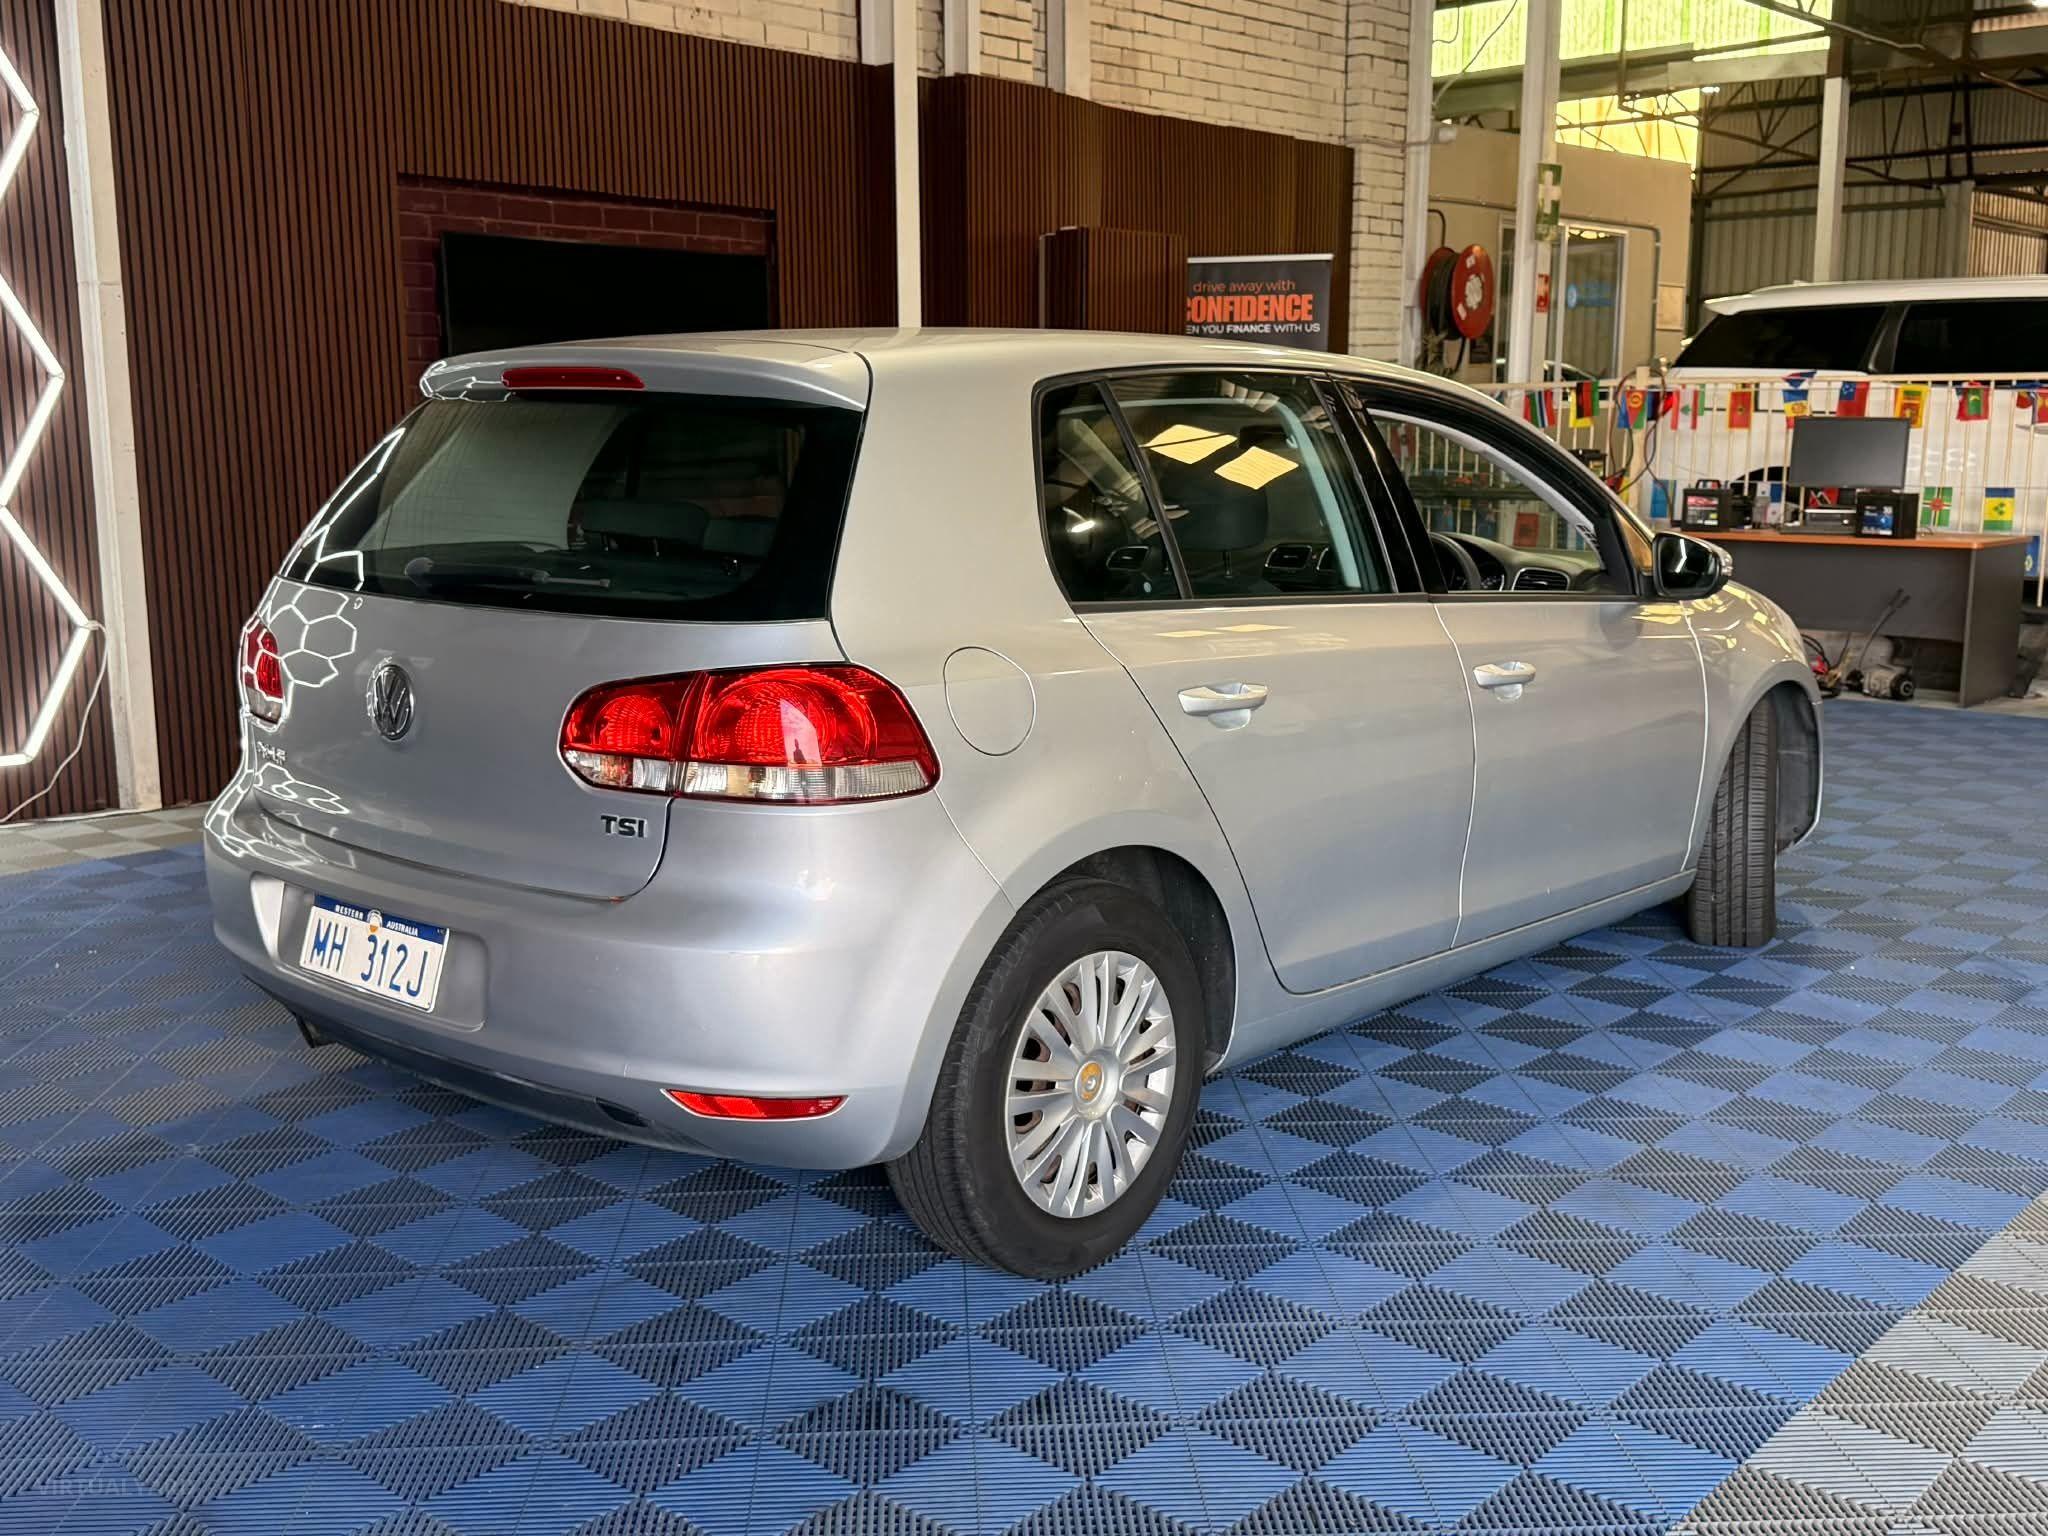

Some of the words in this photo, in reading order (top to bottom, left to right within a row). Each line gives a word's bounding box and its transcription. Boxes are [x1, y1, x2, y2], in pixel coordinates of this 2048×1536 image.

[1193, 282, 1226, 293] drive
[1229, 284, 1263, 295] away
[1264, 280, 1296, 291] with
[1202, 324, 1225, 334] YOU
[1226, 324, 1271, 333] FINANCE
[1273, 324, 1302, 333] WITH
[1304, 323, 1320, 333] US
[600, 814, 647, 838] TSI
[335, 904, 364, 920] WESTERN
[386, 920, 419, 937] AUSTRALIA
[310, 918, 349, 972] MH
[360, 934, 429, 998] 312J
